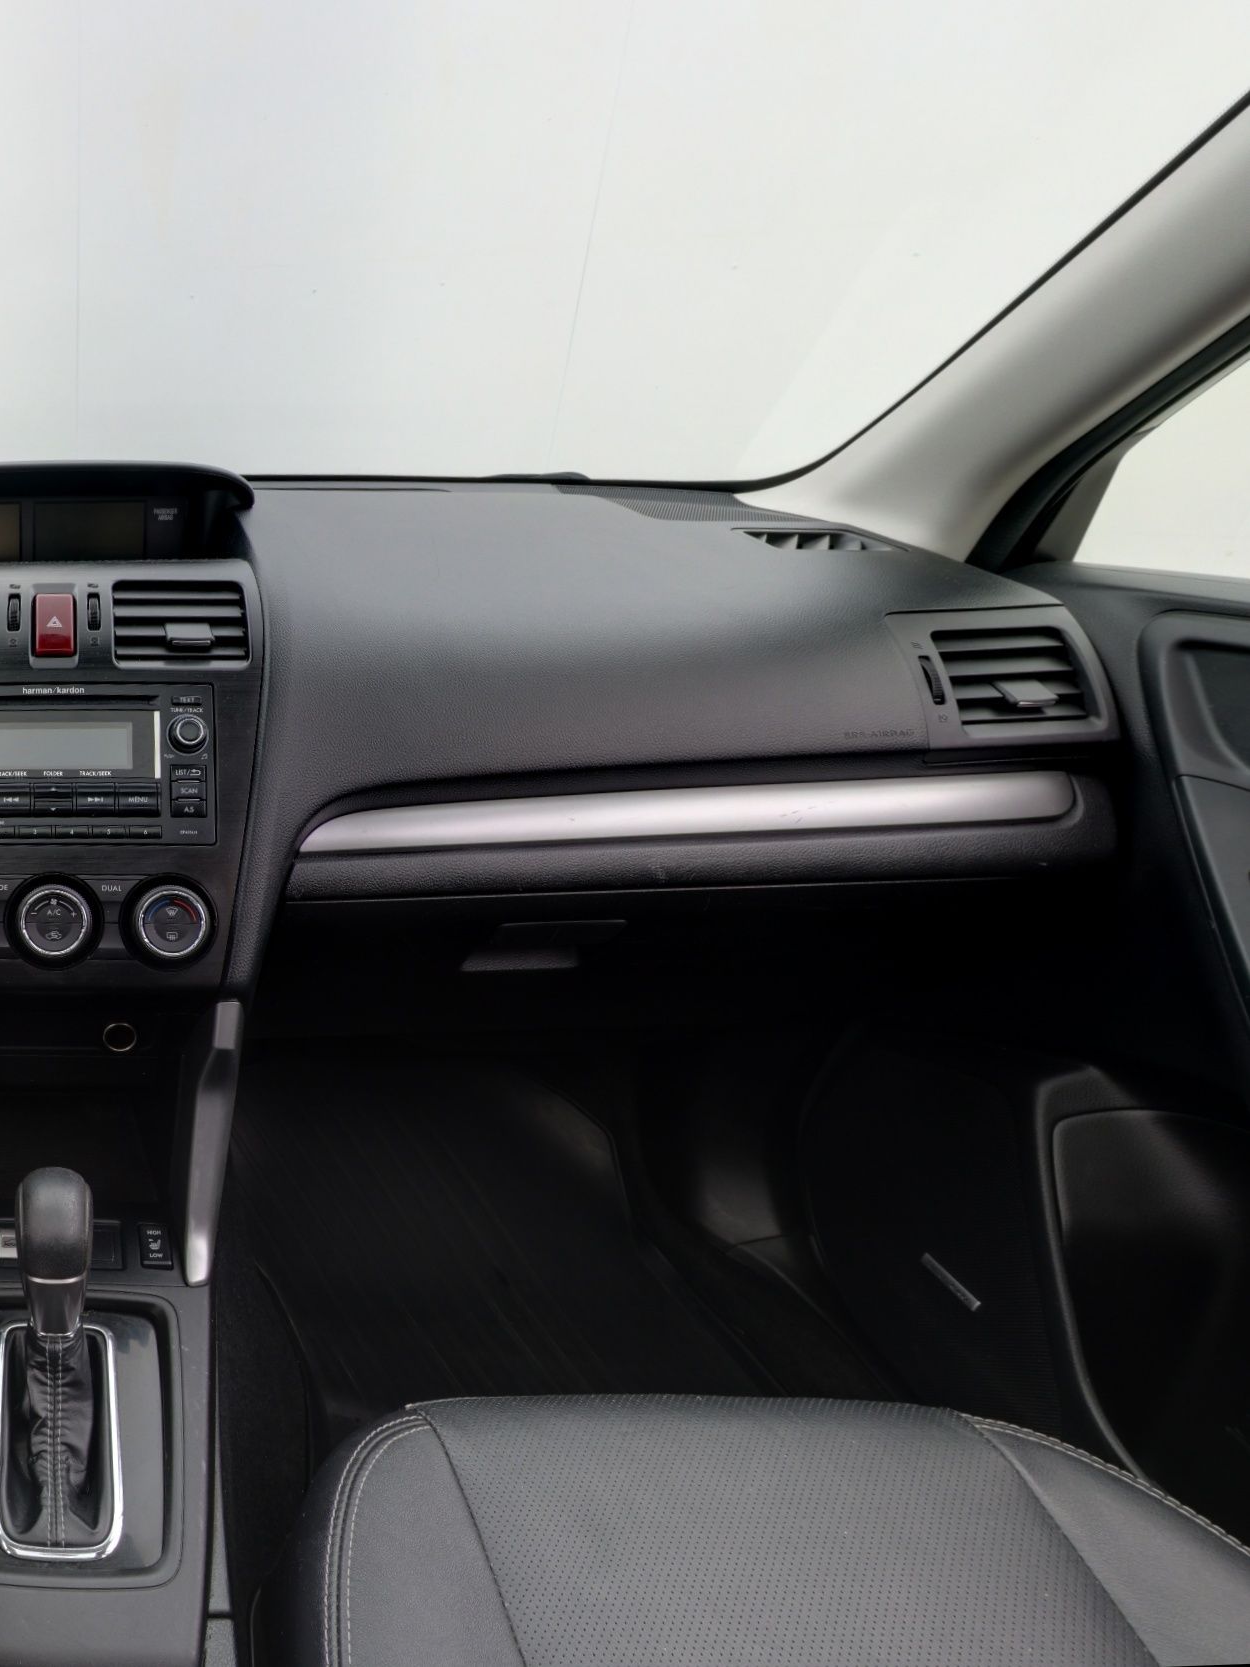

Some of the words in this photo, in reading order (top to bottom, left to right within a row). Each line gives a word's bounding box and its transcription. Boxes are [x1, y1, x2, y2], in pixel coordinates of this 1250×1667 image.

[22, 687, 85, 696] harman/kardon
[180, 789, 199, 797] SCAN
[101, 884, 123, 892] DUAL
[45, 908, 61, 916] A/C
